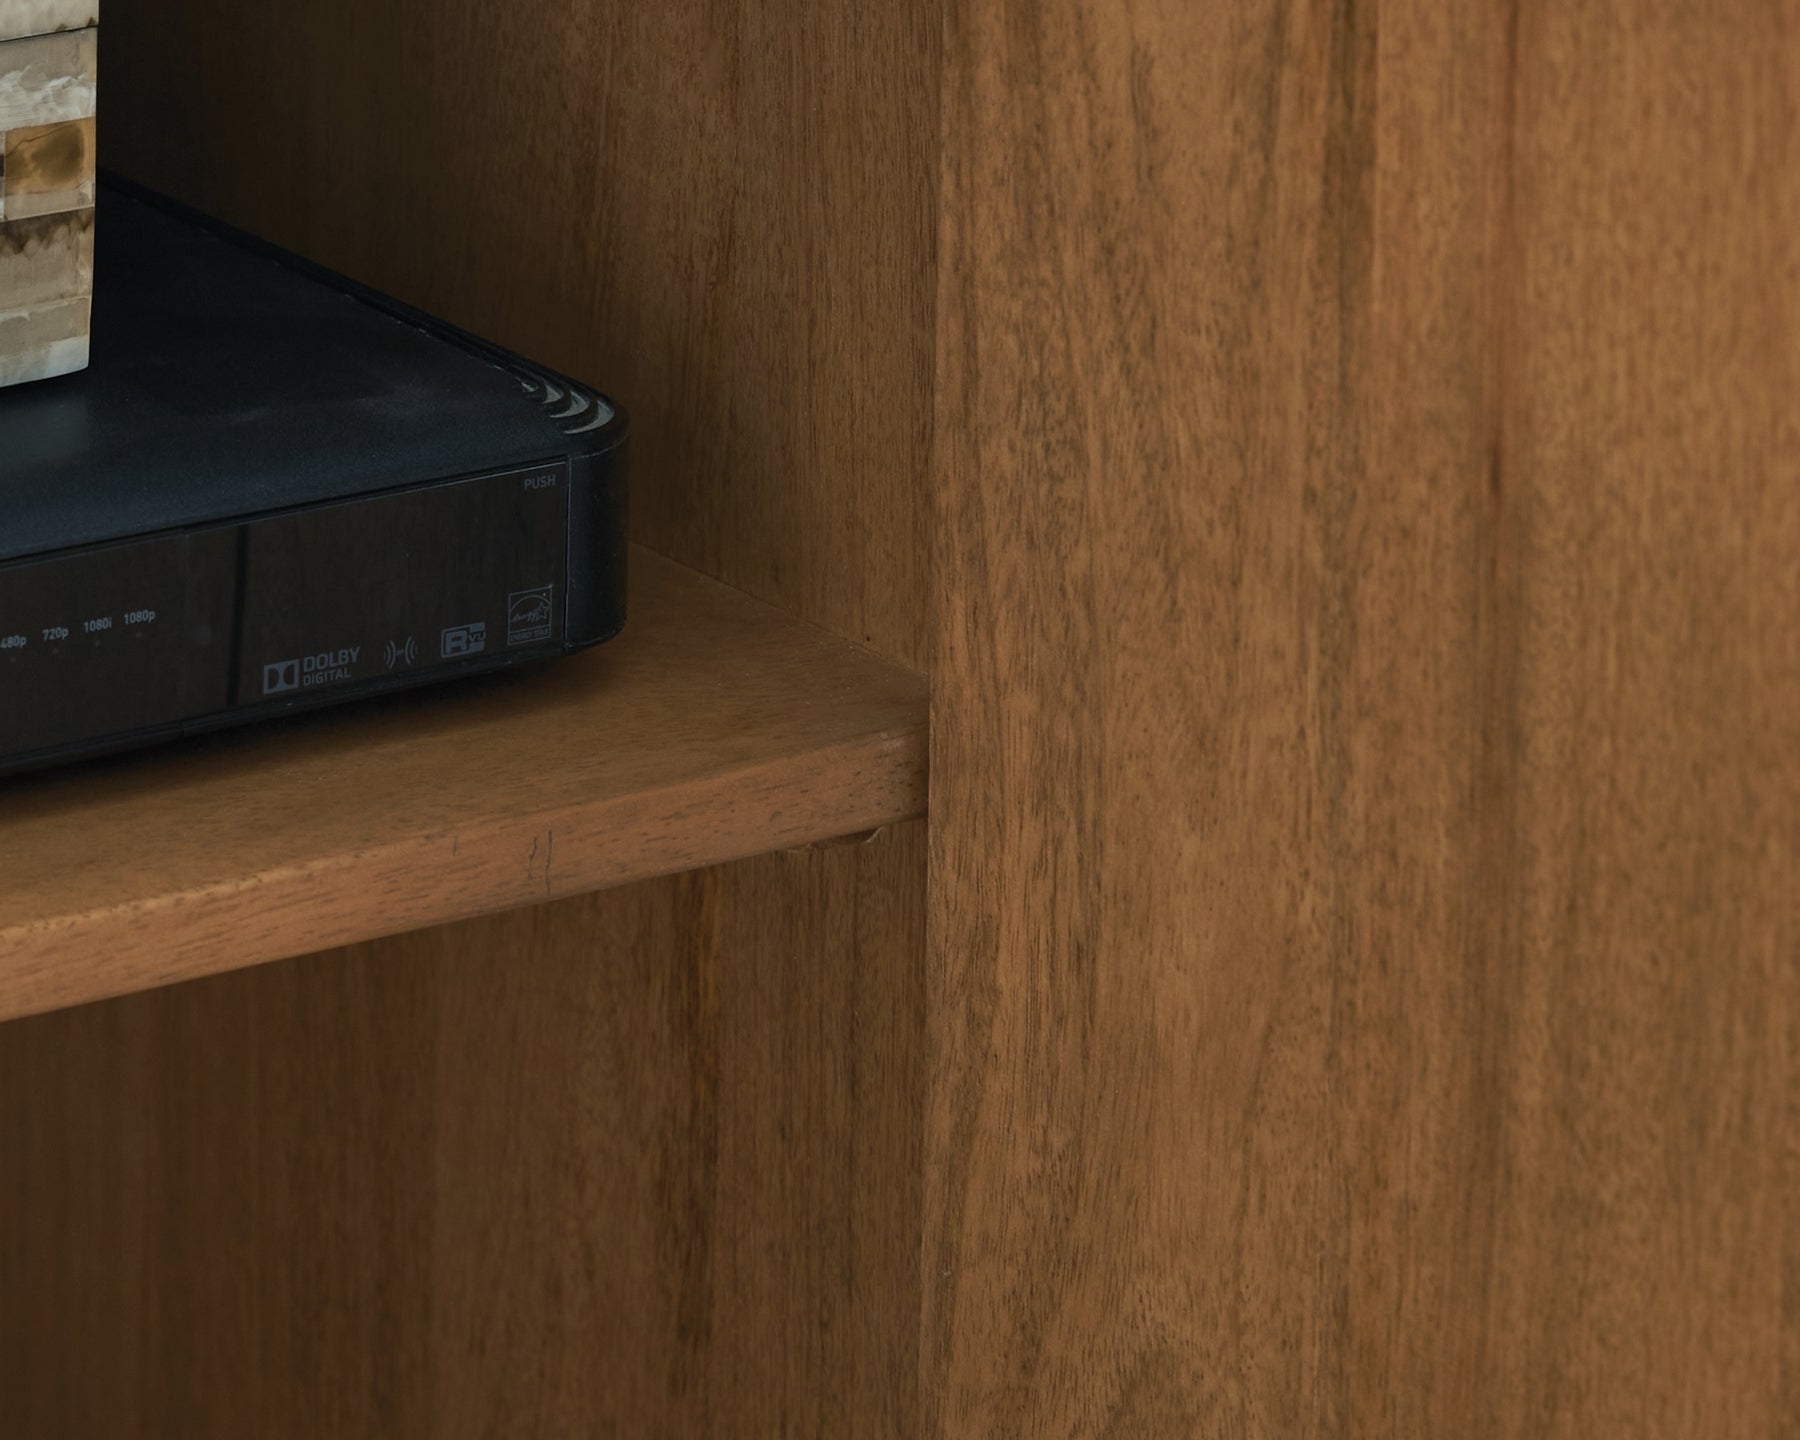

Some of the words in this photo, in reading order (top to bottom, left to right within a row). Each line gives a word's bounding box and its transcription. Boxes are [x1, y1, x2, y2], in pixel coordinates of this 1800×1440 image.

[524, 474, 556, 491] PUSH
[42, 627, 69, 641] 720p
[84, 617, 112, 633] 1080i
[124, 609, 155, 624] 1080p
[303, 646, 360, 672] DOLBY
[303, 667, 351, 687] DIGITAL
